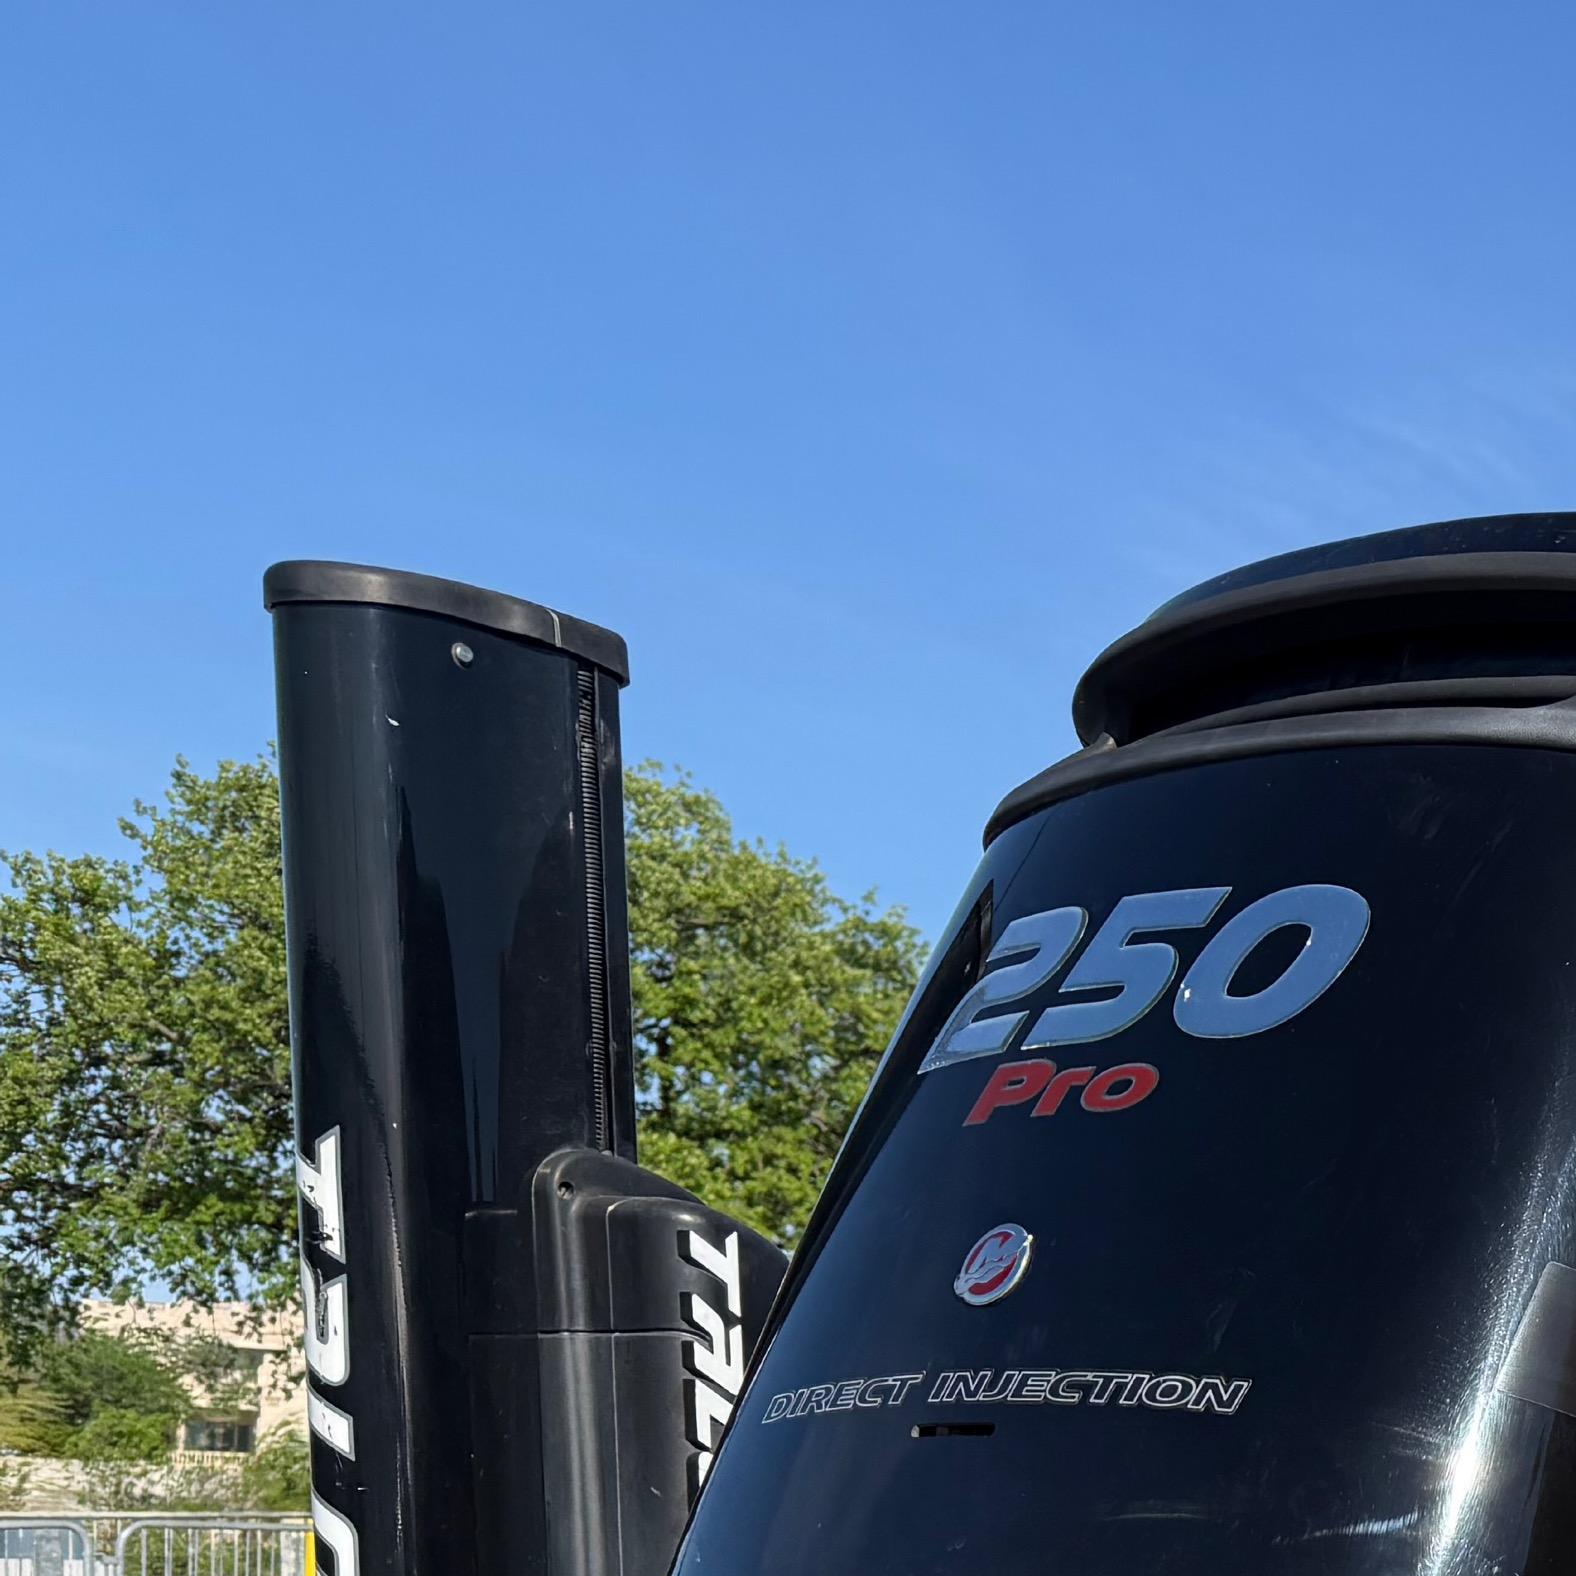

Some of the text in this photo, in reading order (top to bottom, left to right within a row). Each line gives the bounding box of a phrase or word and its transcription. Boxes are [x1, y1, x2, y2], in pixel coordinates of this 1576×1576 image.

[918, 884, 1371, 1074] 250
[963, 1059, 1160, 1126] Pro
[762, 1369, 1252, 1425] DIRECT INJECTION
